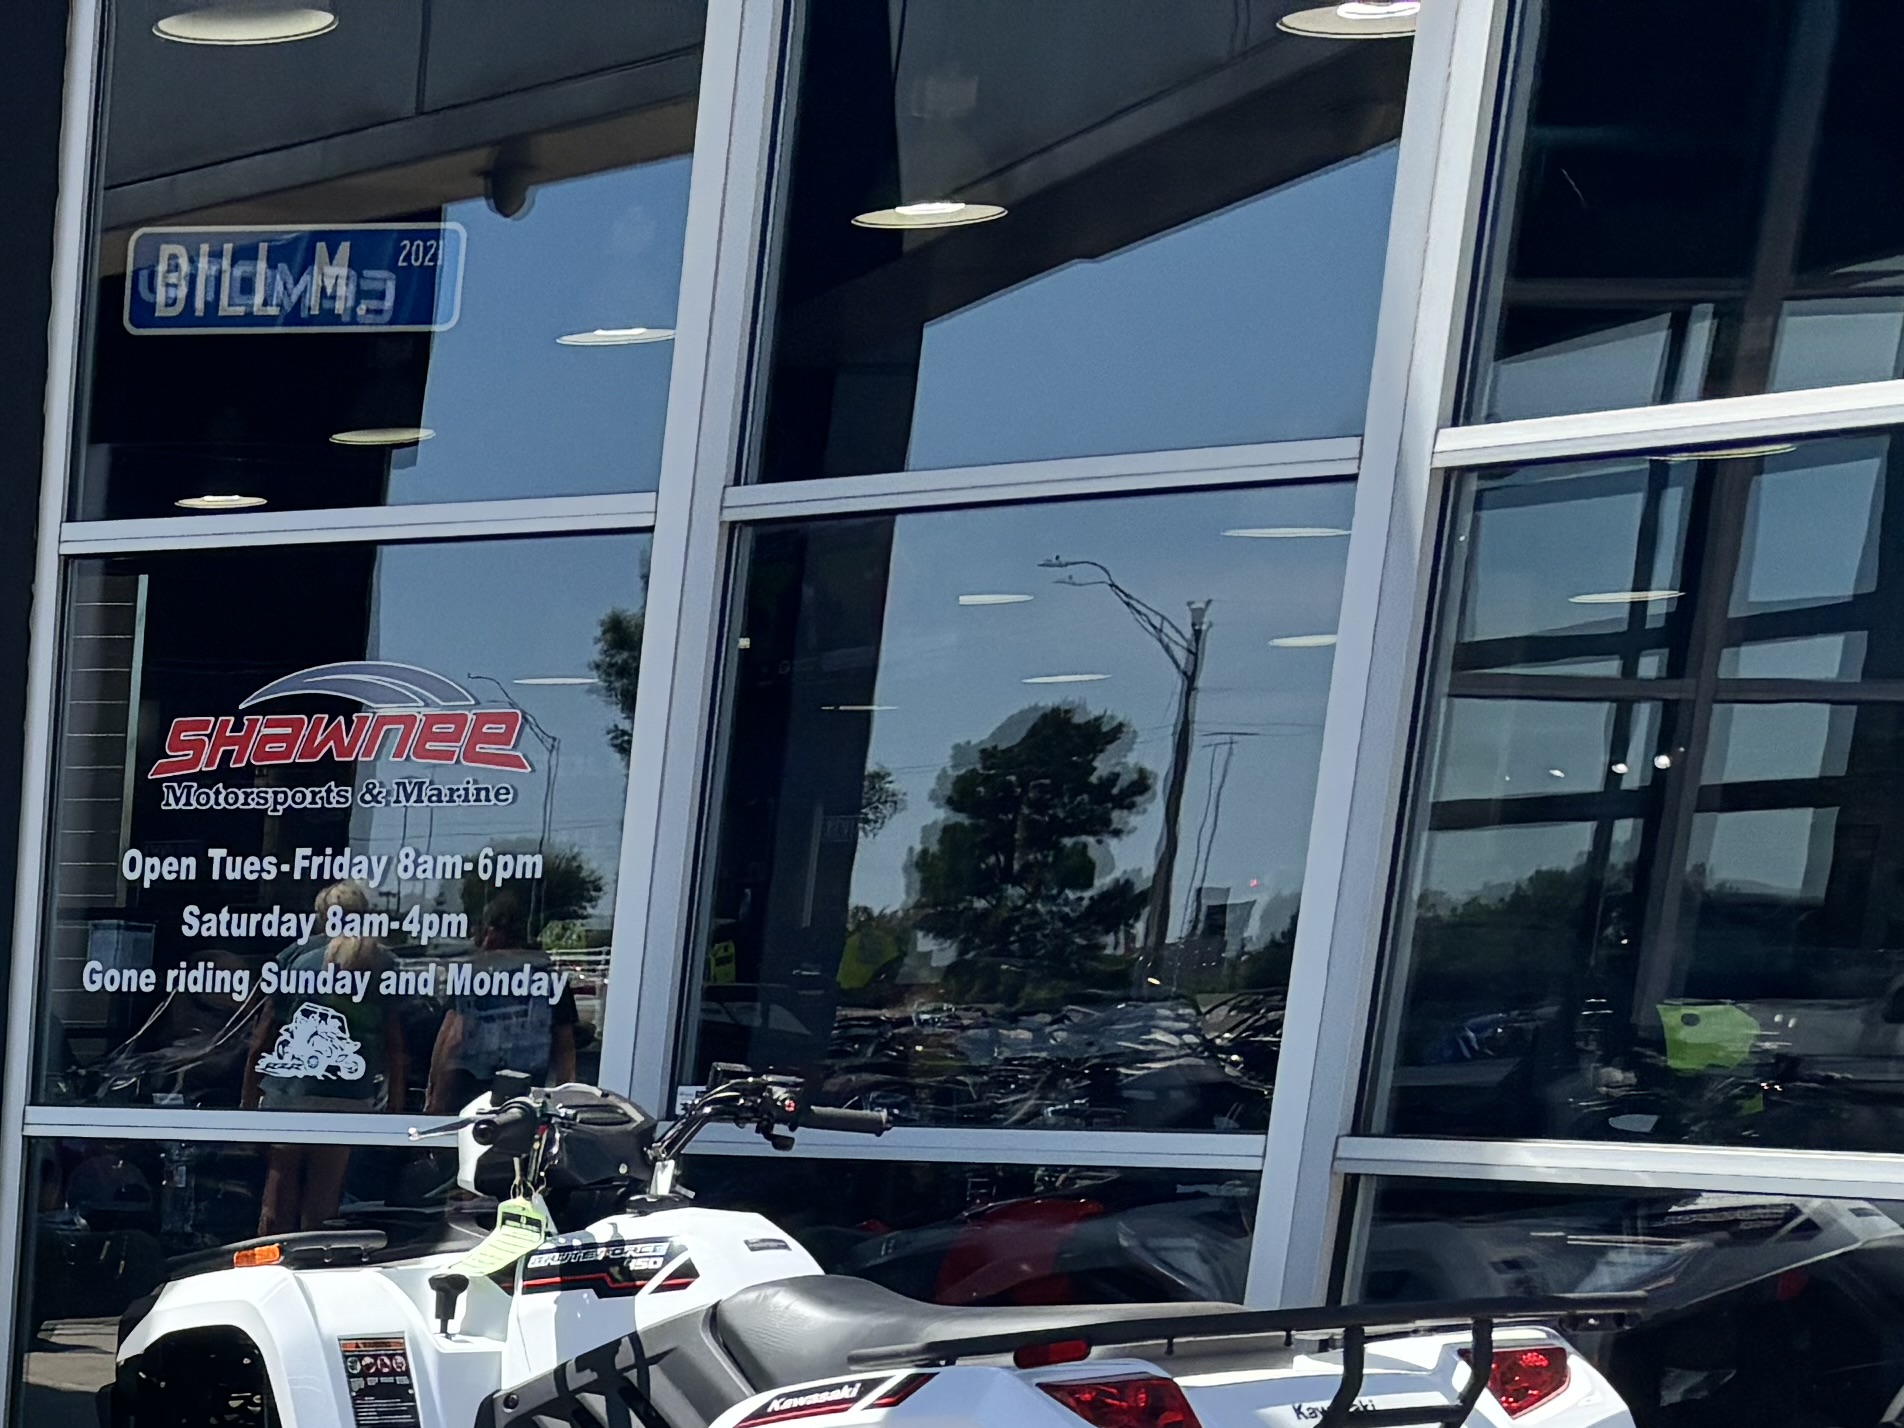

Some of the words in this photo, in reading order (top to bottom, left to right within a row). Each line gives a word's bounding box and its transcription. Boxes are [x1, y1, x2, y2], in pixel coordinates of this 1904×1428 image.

[154, 243, 284, 318] BILL
[161, 781, 351, 815] Motorsports
[358, 780, 386, 807] &
[392, 779, 517, 808] Marine
[122, 849, 196, 888] Open
[208, 847, 387, 888] Tues-Friday
[397, 847, 543, 887] 8am-6pm
[182, 906, 315, 946] Saturday
[325, 906, 468, 945] 8am-4pm
[83, 961, 156, 994] Gone
[166, 961, 249, 1001] riding
[260, 962, 370, 1003] Sunday
[379, 963, 435, 996] and
[446, 963, 568, 1006] Monday
[767, 1383, 862, 1413] Kawasaki
